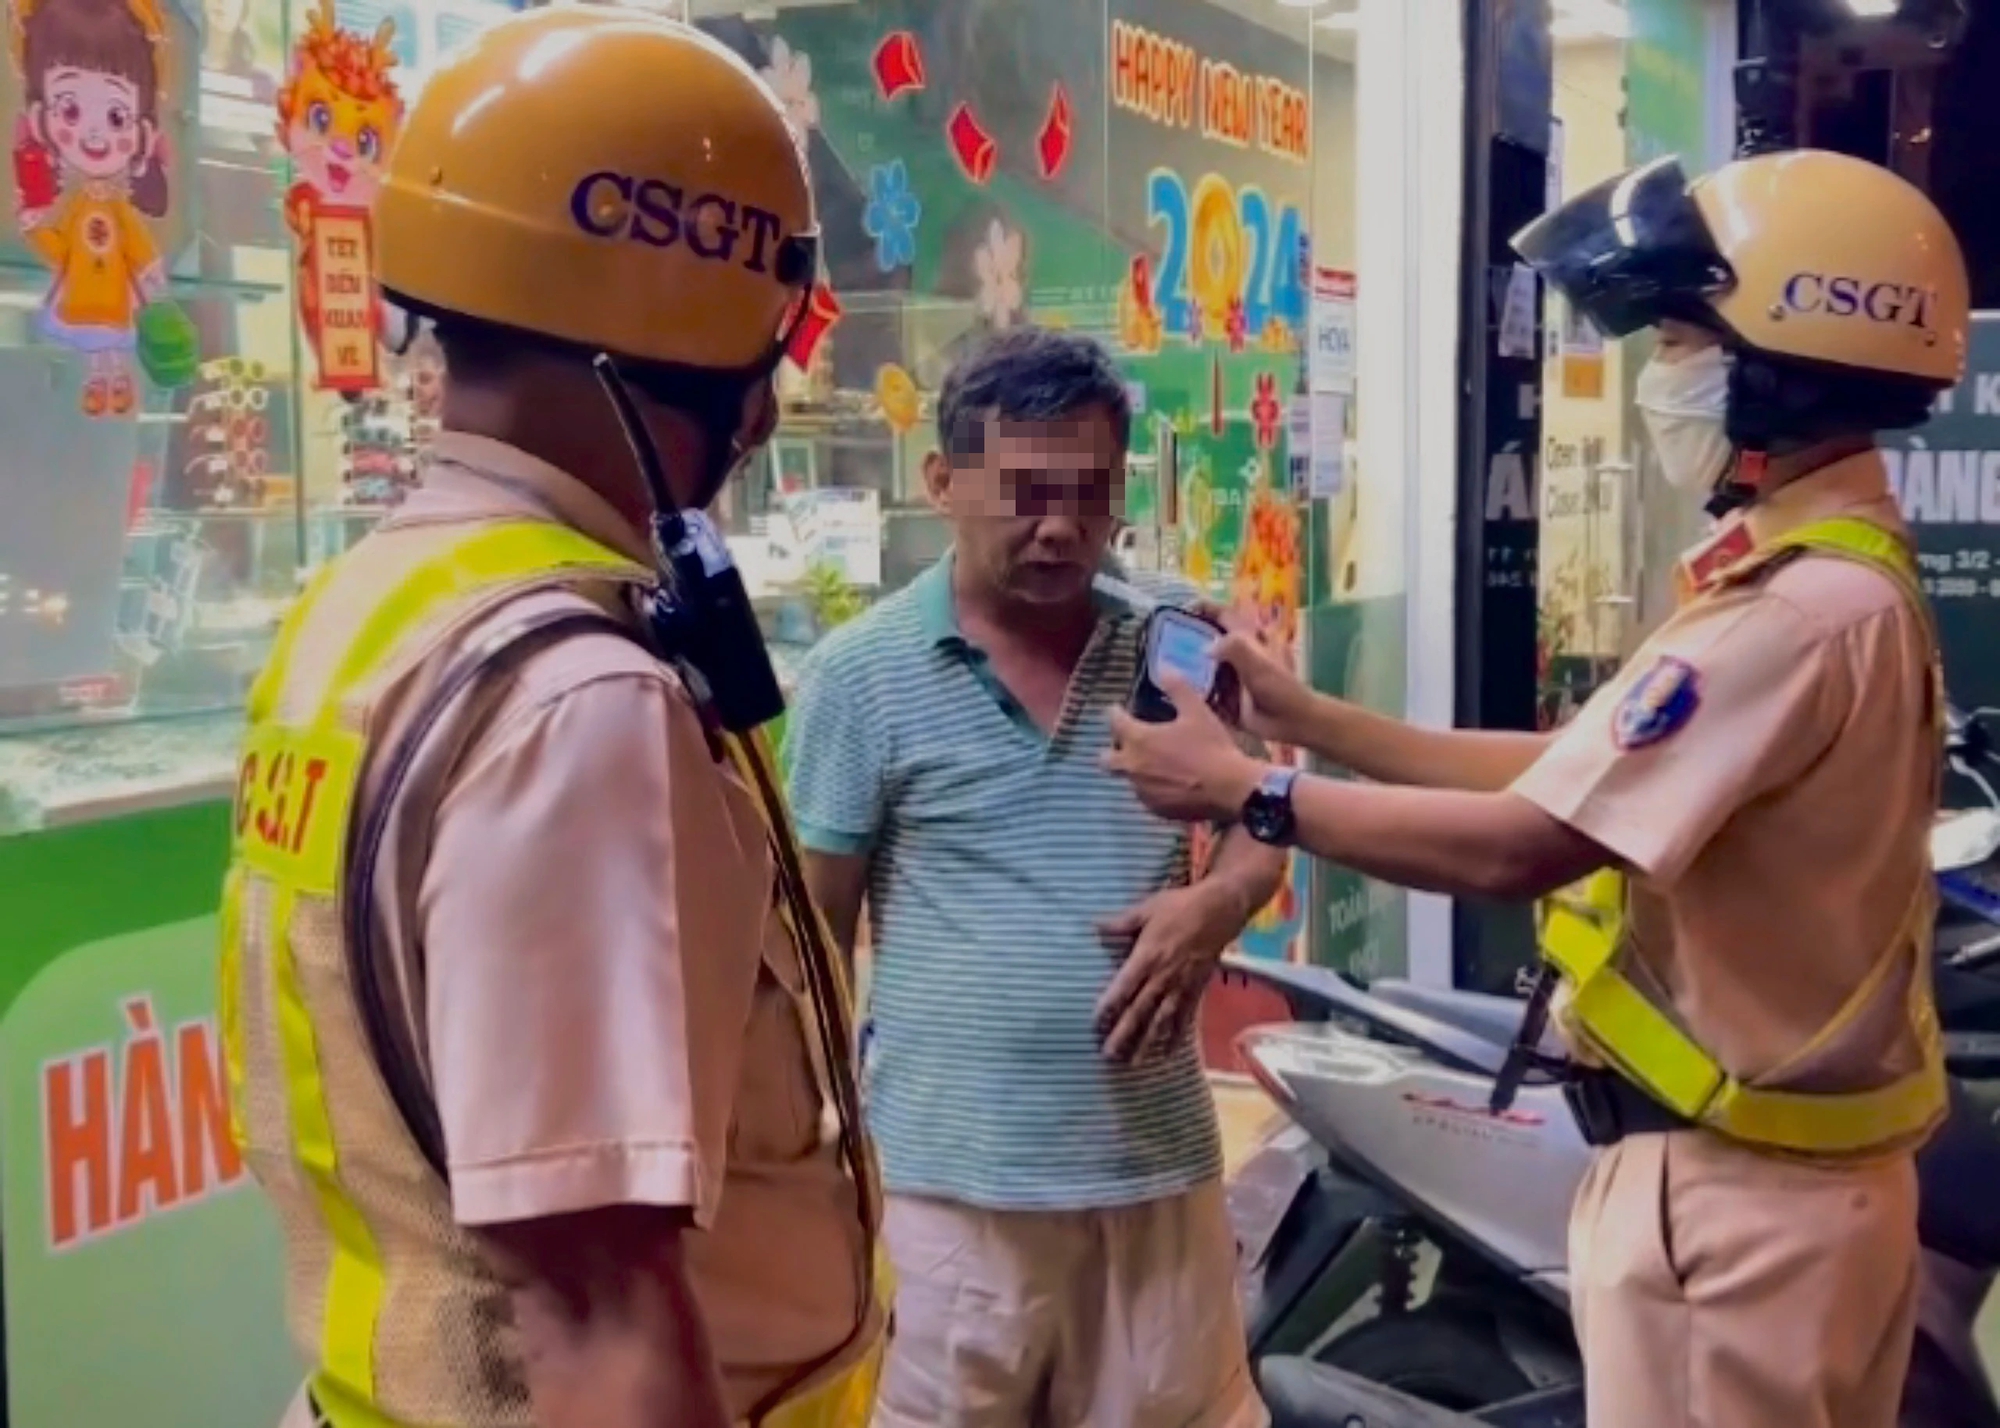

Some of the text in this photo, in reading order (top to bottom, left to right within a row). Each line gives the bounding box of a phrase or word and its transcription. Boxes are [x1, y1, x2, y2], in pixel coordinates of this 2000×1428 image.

[1113, 20, 1309, 164] HAPPY NEW YEAR
[571, 171, 781, 273] CSGT
[1148, 167, 1309, 340] 2024
[1784, 272, 1938, 328] CSGT
